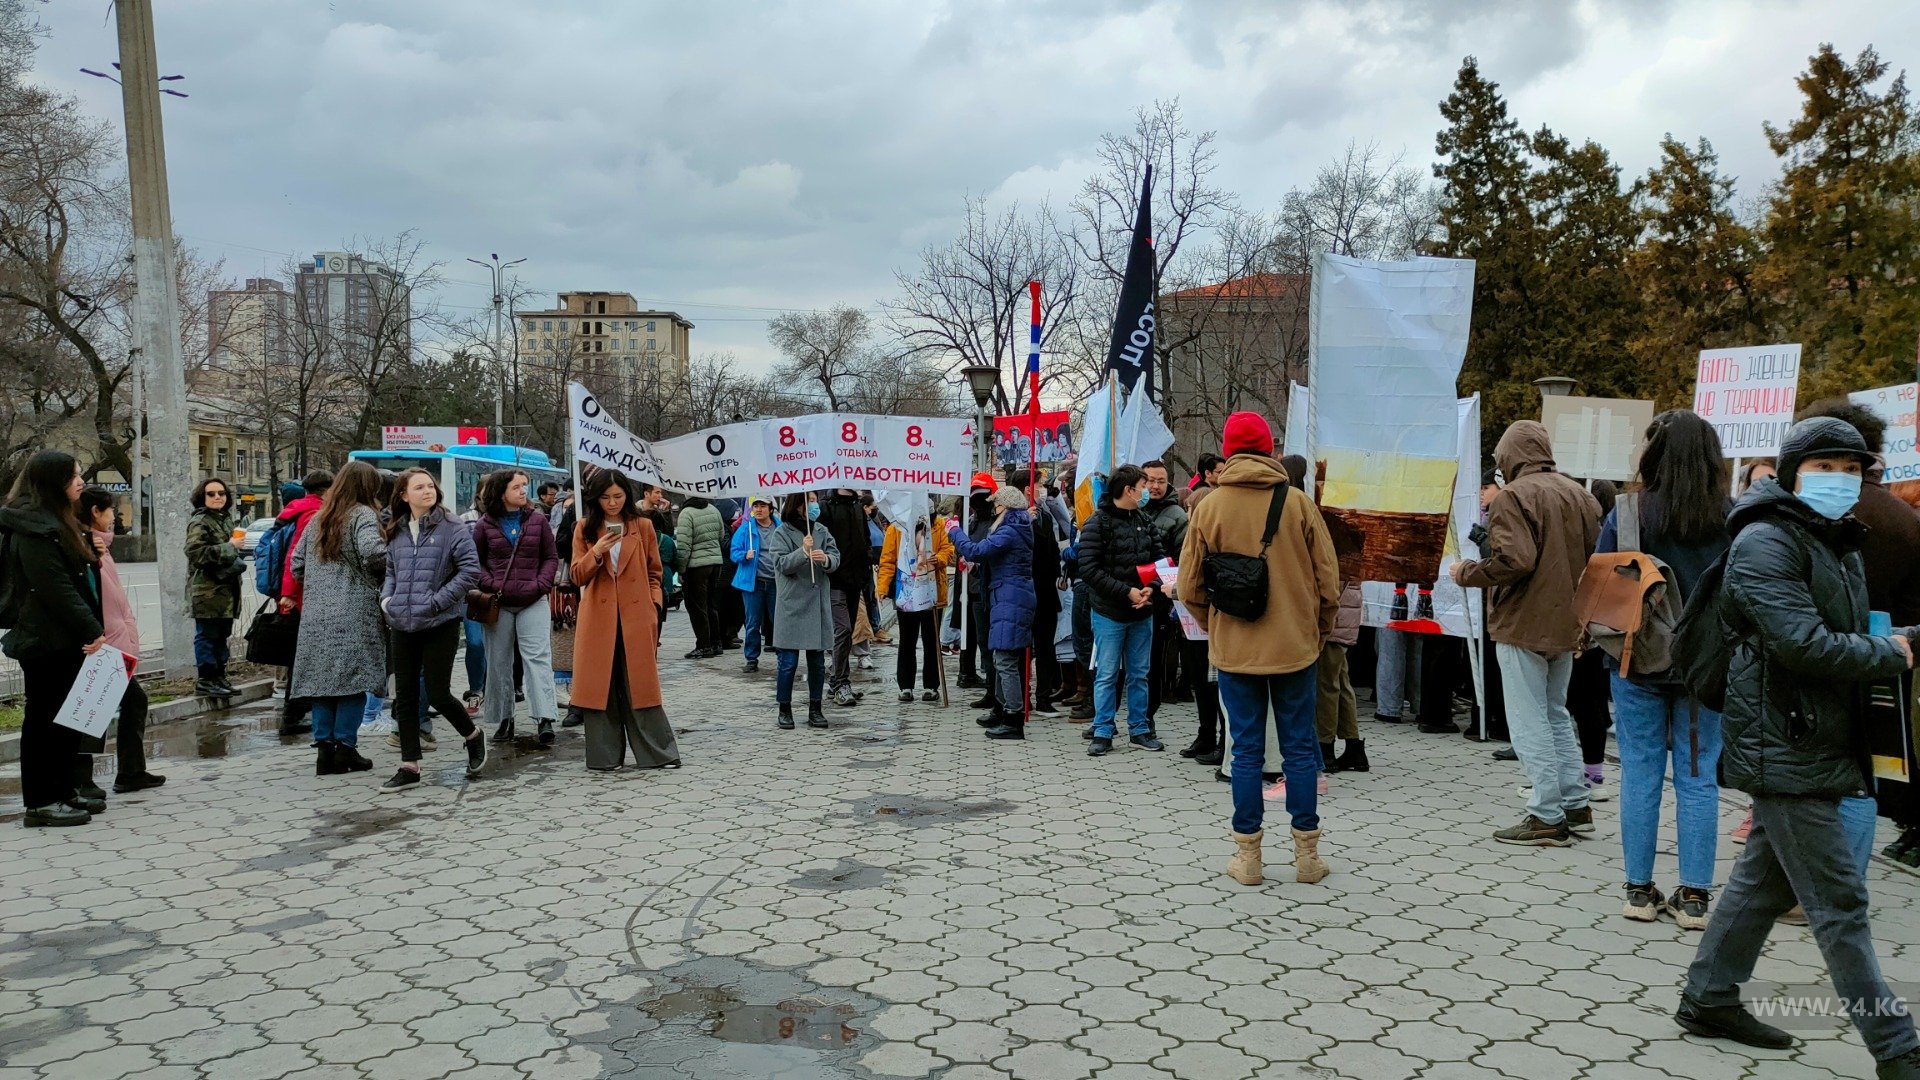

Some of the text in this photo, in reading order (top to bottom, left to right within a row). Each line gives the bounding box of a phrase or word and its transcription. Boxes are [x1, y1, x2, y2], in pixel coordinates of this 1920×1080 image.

[1700, 357, 1740, 384] БИТЬ
[1877, 391, 1888, 404] Я
[579, 419, 617, 439] ТАНКОВ
[779, 425, 796, 447] 8
[841, 421, 858, 443] 8
[906, 425, 923, 447] 8
[1712, 421, 1791, 449] СТУПЛЕНИ
[776, 450, 817, 462] РАБОТЫ
[836, 448, 879, 458] ОТДЫХА
[908, 452, 931, 461] СНА
[699, 458, 740, 473] ПОТЕРЬ
[757, 462, 961, 488] КАЖДОЙ РАБОТНИЦЕ!
[657, 474, 738, 494] МАТЕРИ!
